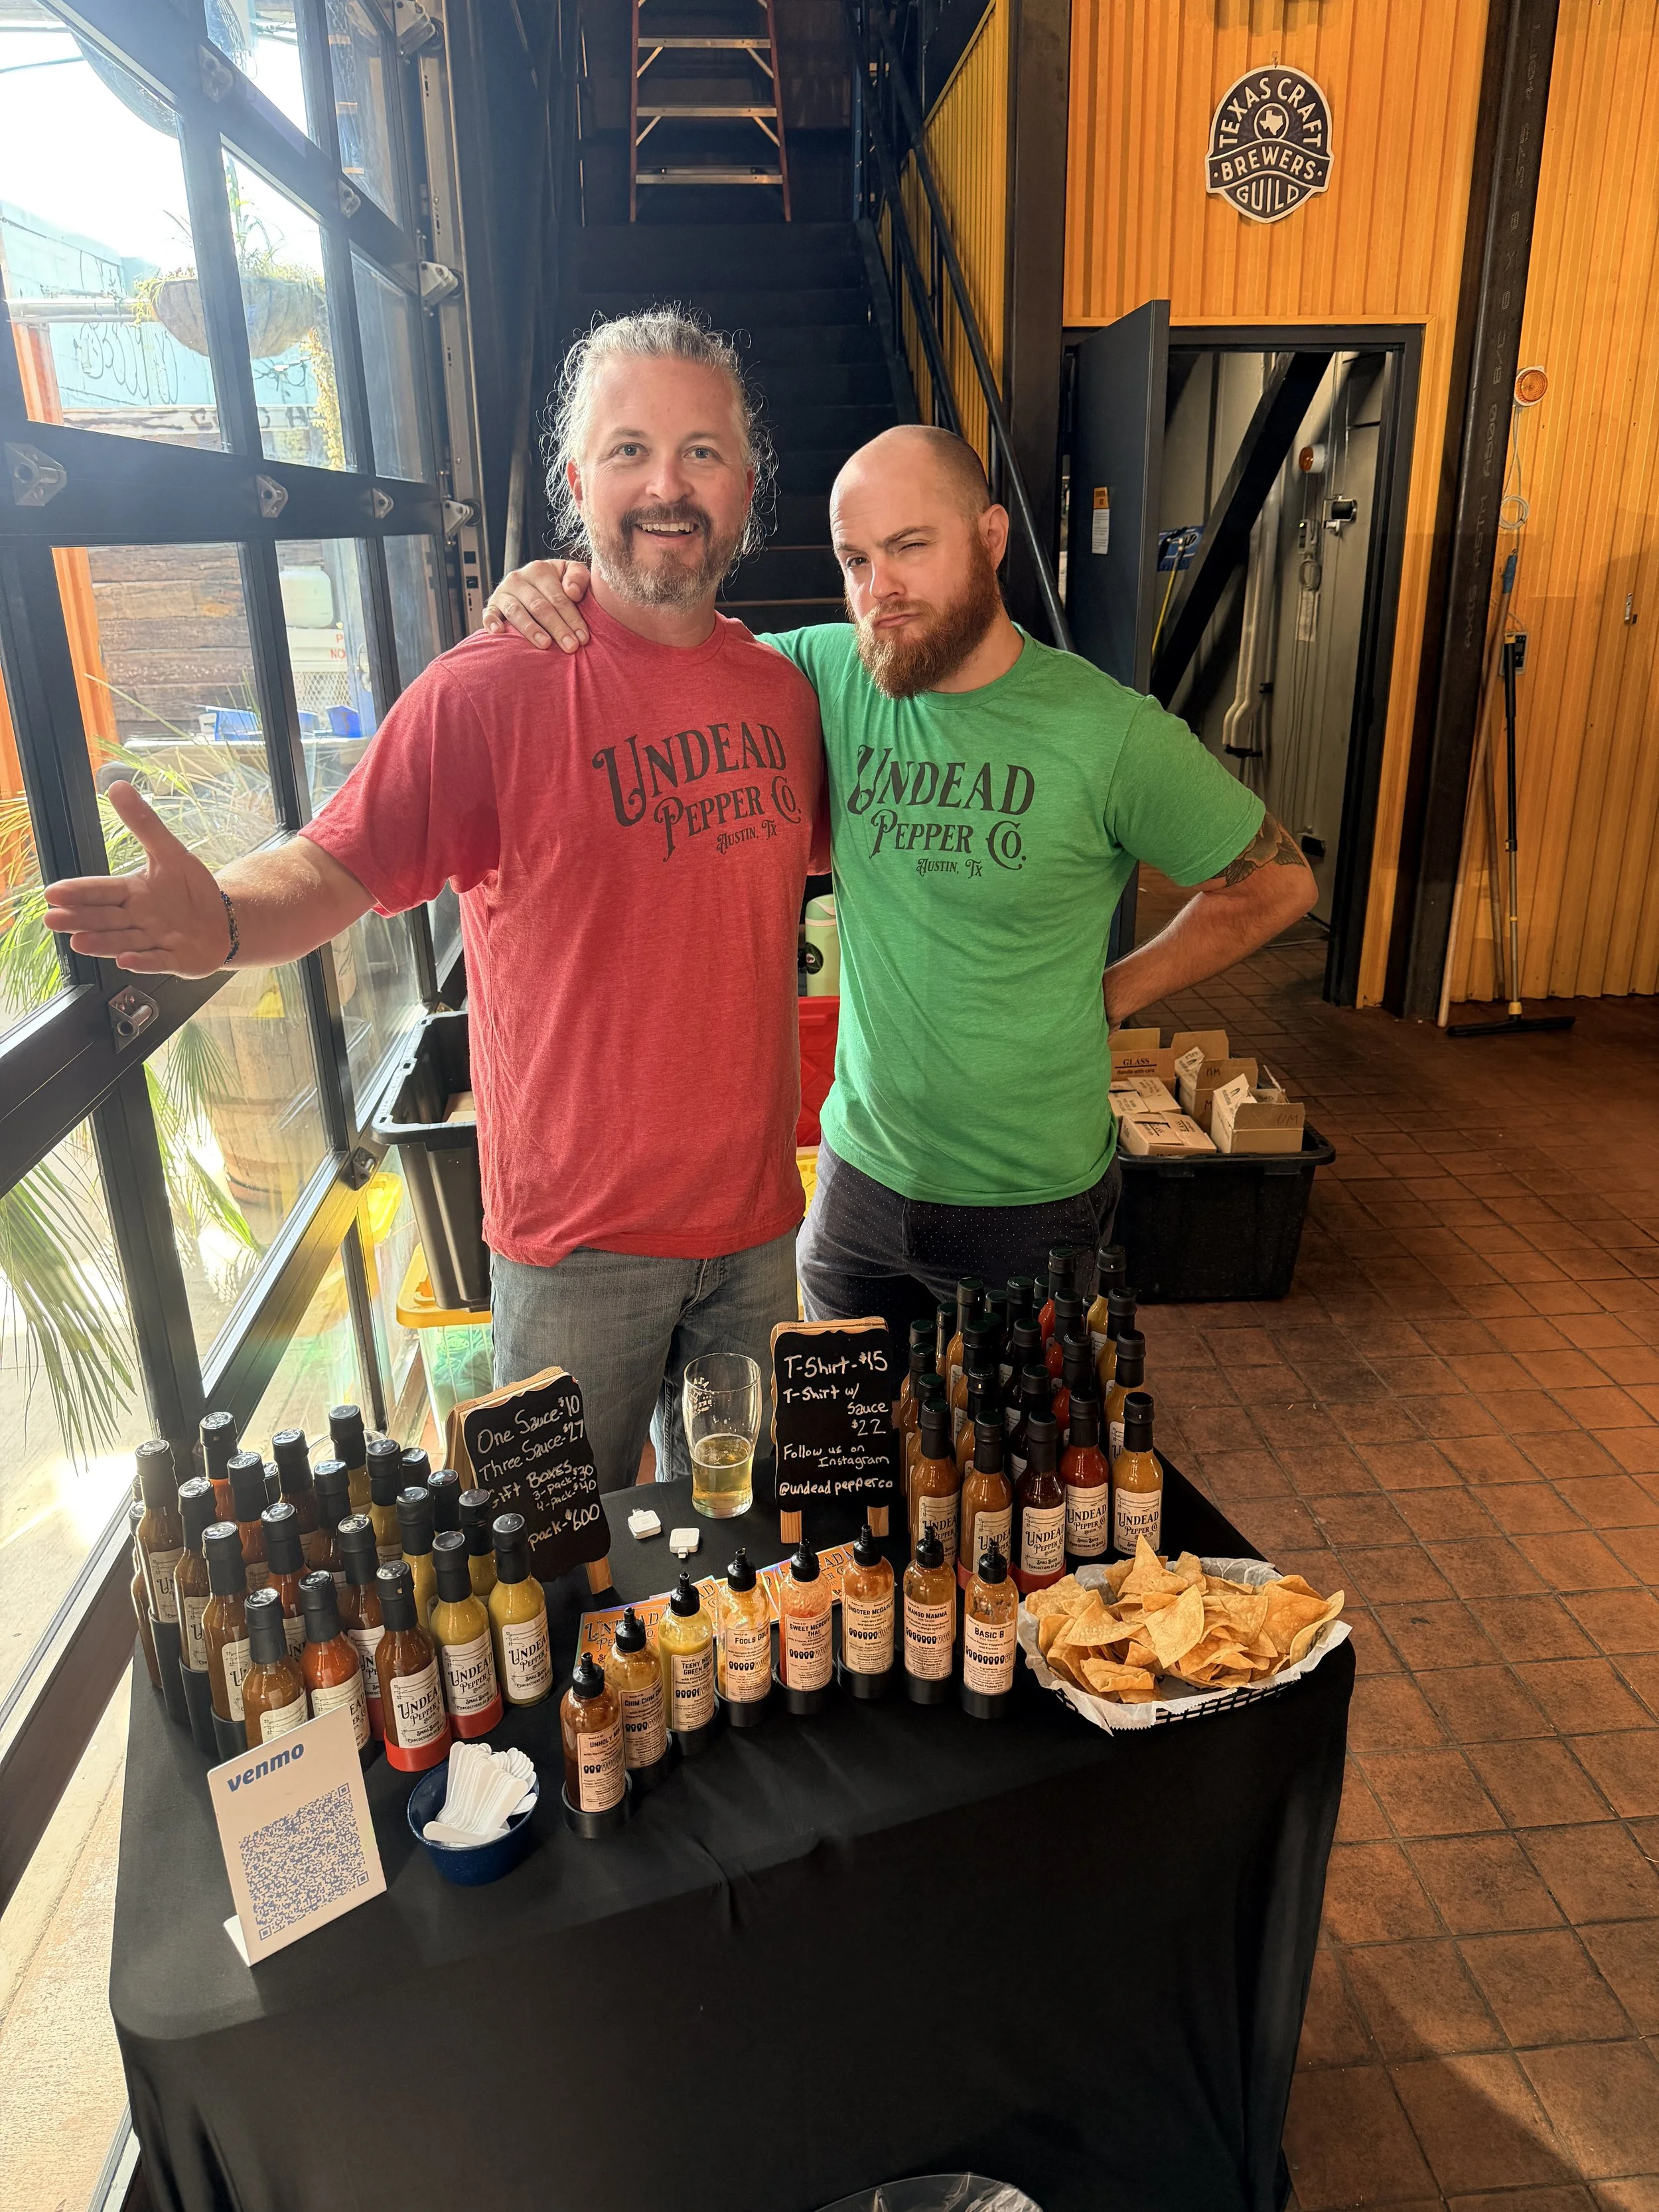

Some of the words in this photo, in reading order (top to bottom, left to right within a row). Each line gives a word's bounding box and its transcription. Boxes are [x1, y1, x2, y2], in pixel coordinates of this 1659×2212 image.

[1219, 77, 1271, 148] TEXAS
[1277, 78, 1322, 147] CRAFT
[1220, 145, 1316, 181] BREWERS
[1236, 177, 1299, 213] GUILD
[592, 721, 786, 827] UNDEAD
[847, 744, 1035, 816] UNDEAD
[653, 785, 765, 863] PEPPER
[869, 808, 974, 859] PEPPER
[1123, 1057, 1150, 1066] GLASS
[845, 1382, 860, 1399] w/
[851, 1418, 887, 1437] $22
[477, 1428, 516, 1454] One
[783, 1443, 822, 1460] Follow
[828, 1445, 842, 1454] us
[478, 1455, 524, 1481] Three
[818, 1455, 890, 1469] Instagram
[1067, 1504, 1107, 1524] UNDEAD
[1117, 1511, 1159, 1527] UNDEAD
[1074, 1520, 1098, 1532] PEPPER
[1124, 1526, 1149, 1536] PEPPER
[978, 1527, 1011, 1550] UNDEA
[1034, 1540, 1058, 1555] PEPPER
[974, 1627, 997, 1639] BASIC
[999, 1630, 1005, 1639] B
[520, 1649, 545, 1672] PEPPER
[682, 1660, 701, 1669] TEENY
[684, 1666, 702, 1675] GREEN
[459, 1673, 487, 1695] PEPPER
[641, 1695, 655, 1704] CHIM
[410, 1701, 437, 1726] PEPPER
[589, 1735, 612, 1748] UNHOLY
[226, 1743, 305, 1793] venmo
